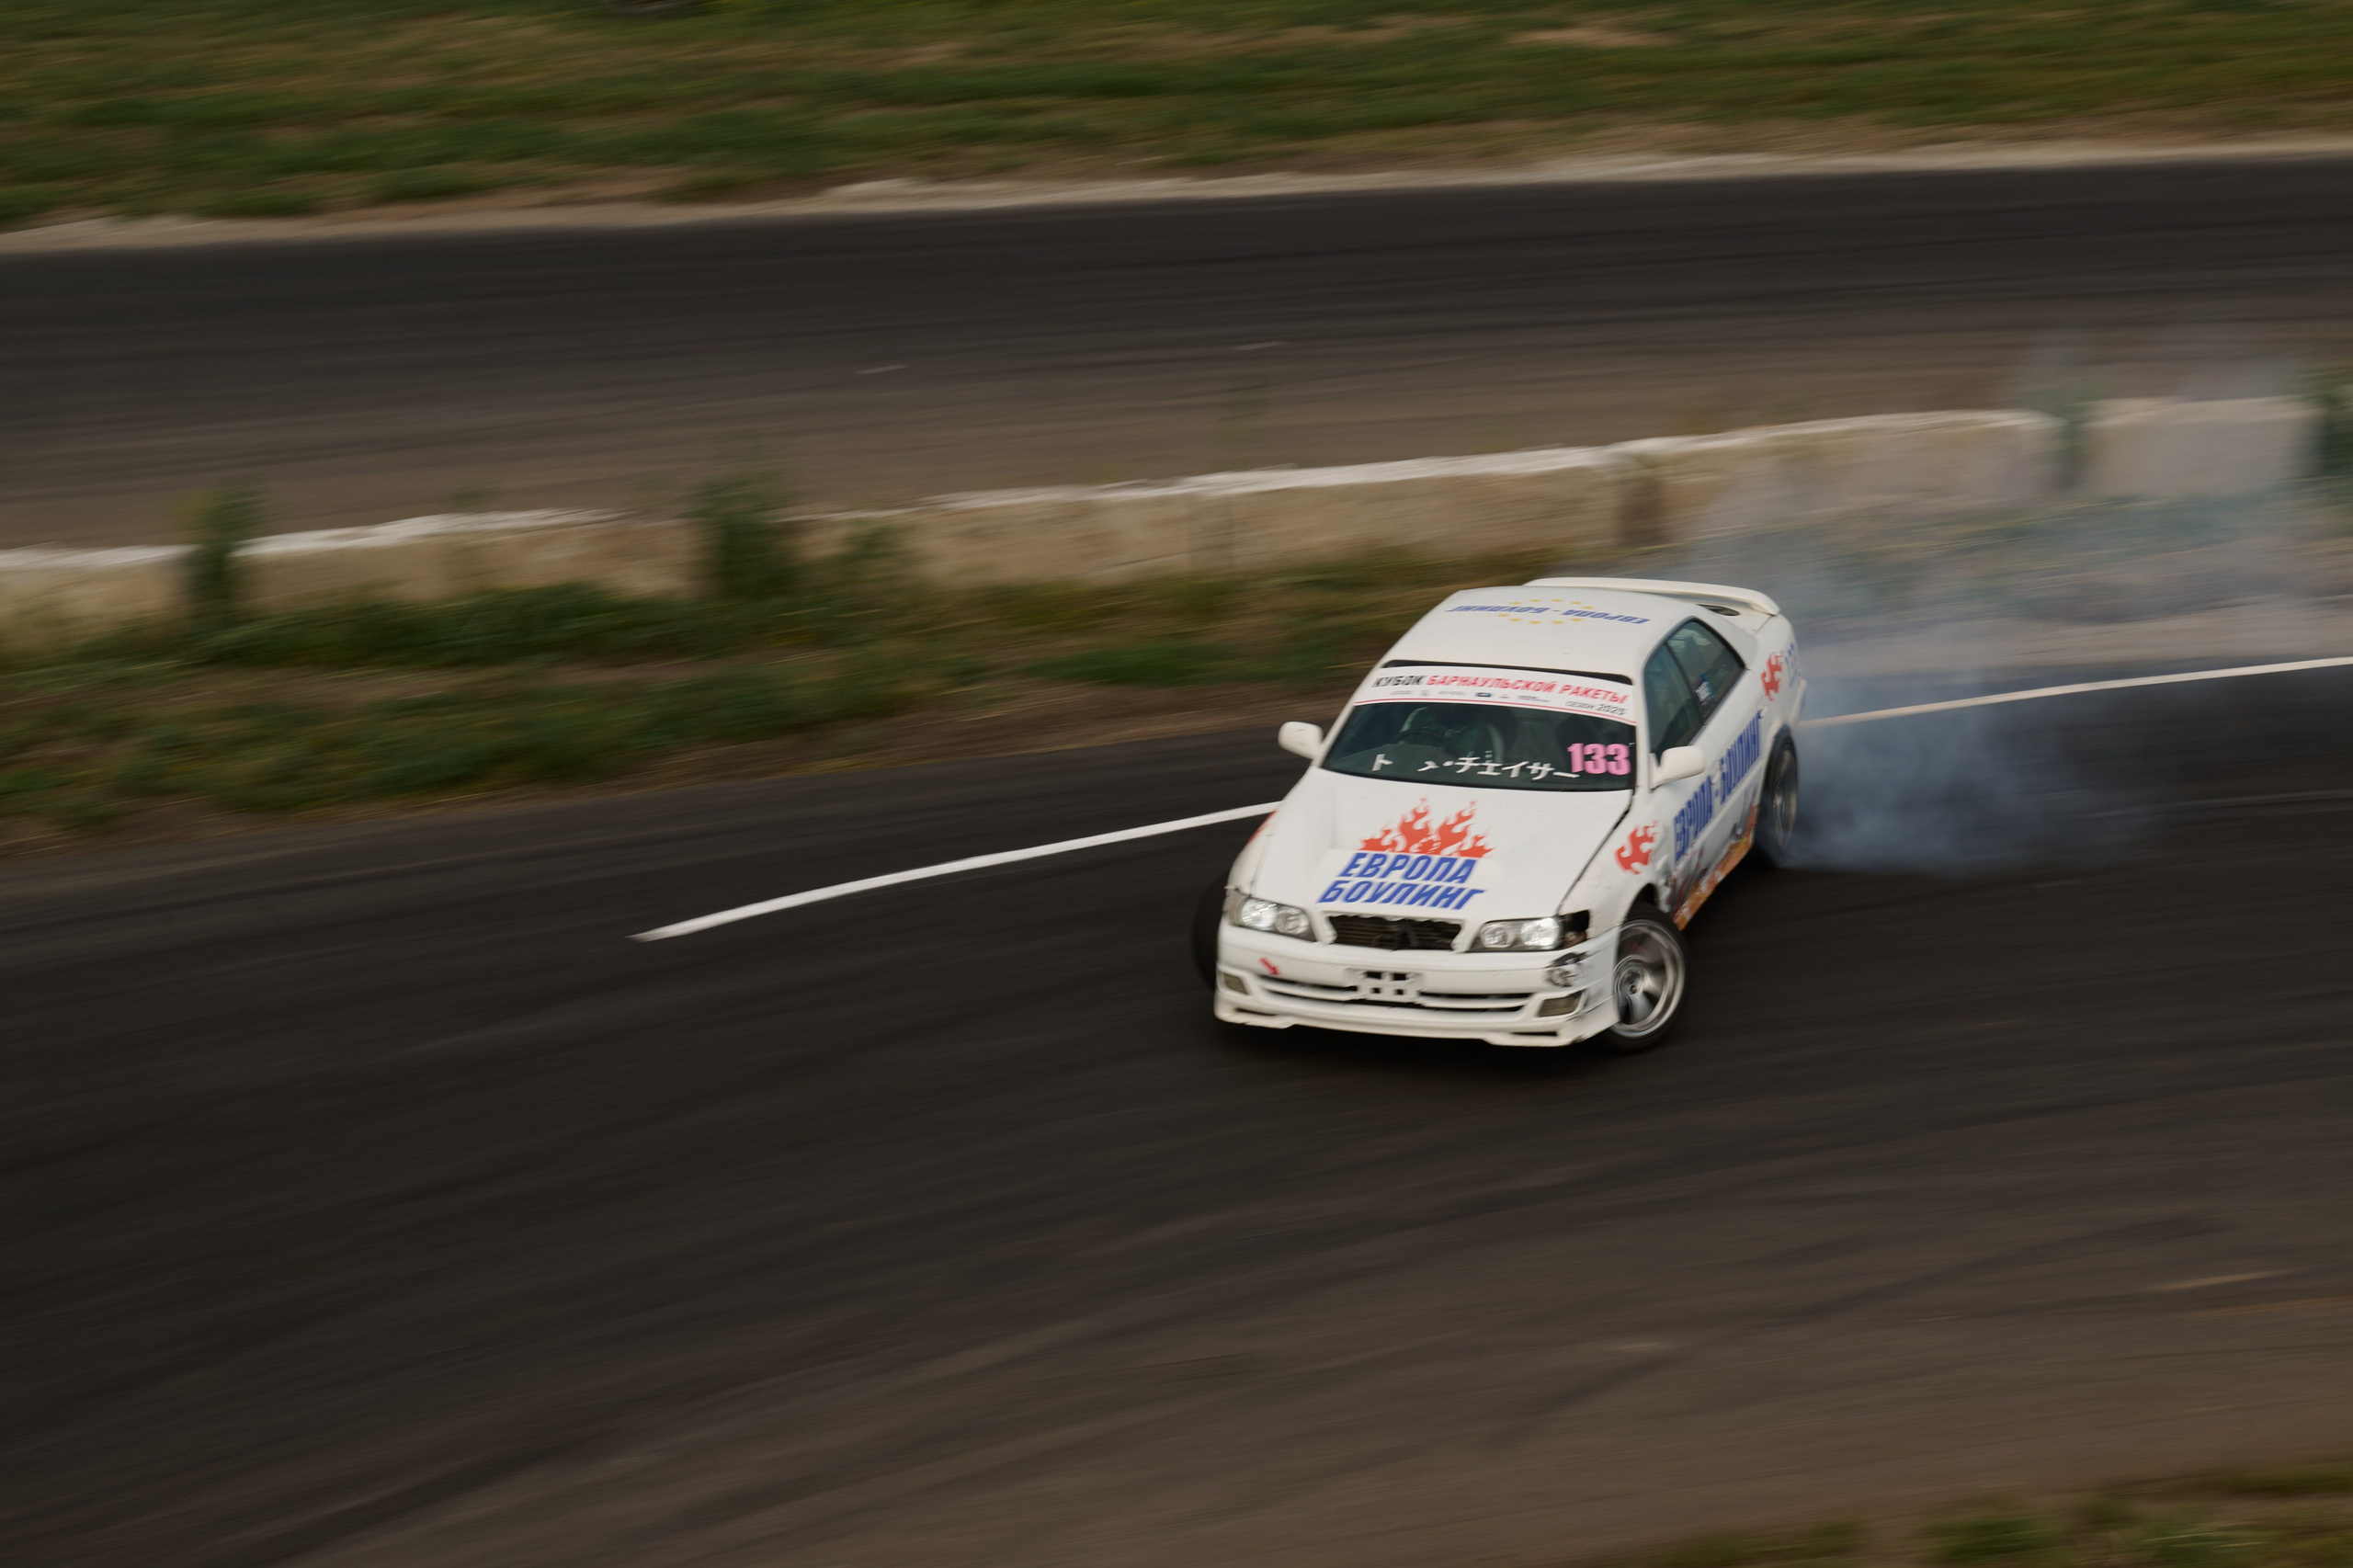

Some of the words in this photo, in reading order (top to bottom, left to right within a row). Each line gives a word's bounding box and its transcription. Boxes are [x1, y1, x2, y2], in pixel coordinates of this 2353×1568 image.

[1445, 605, 1550, 614] БОУЛИНГ
[1562, 608, 1651, 624] ЕВРОПА
[1373, 676, 1427, 687] КУБОК
[1426, 675, 1557, 694] БАРНАУЛЬСКОЙ
[1559, 684, 1630, 704] РАКЕТЫ
[1567, 743, 1631, 776] 133
[1673, 776, 1714, 863] ЕВРОПА
[1719, 709, 1764, 804] БОУЛИНГ
[1336, 852, 1478, 884] ЕВРОПА
[1316, 880, 1487, 910] БОУЛИНГ
